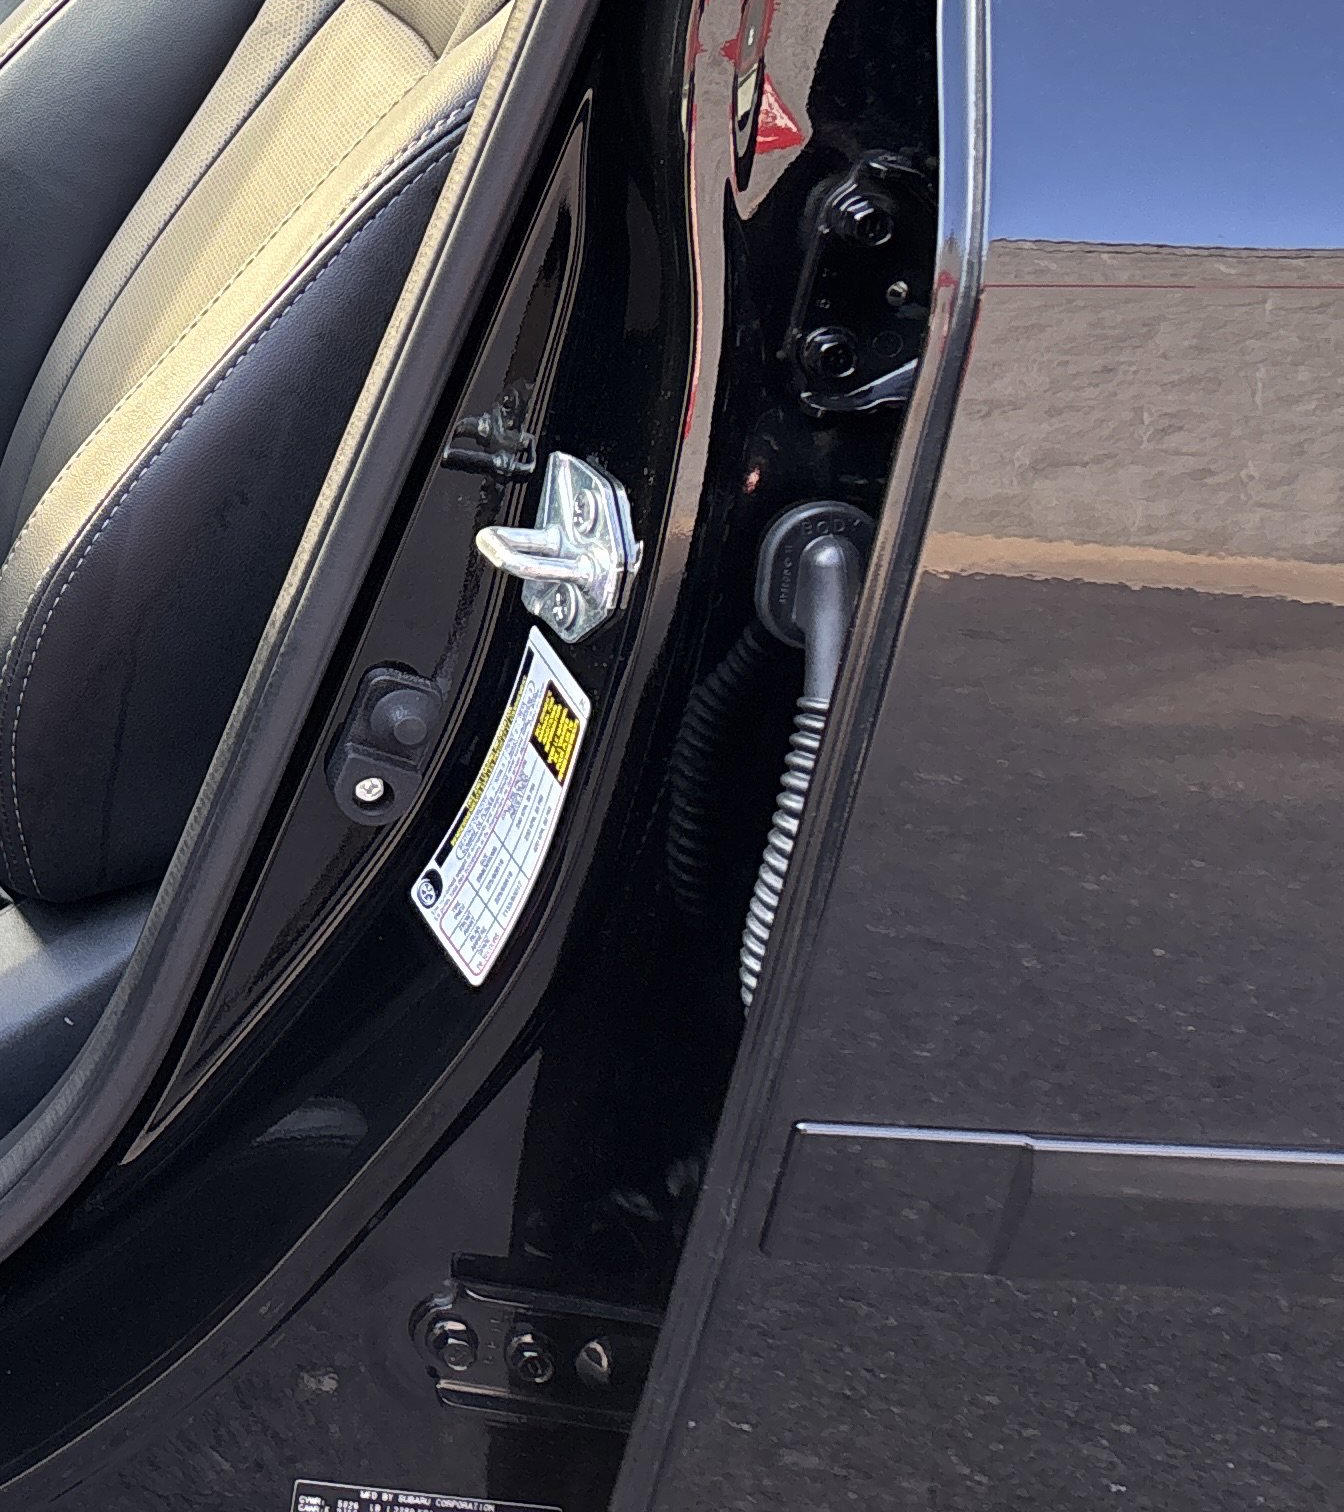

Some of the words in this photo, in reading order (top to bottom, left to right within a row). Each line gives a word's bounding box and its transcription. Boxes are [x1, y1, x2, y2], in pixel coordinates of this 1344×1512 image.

[382, 1492, 394, 1501] BY
[397, 1494, 431, 1506] SUBARU
[435, 1498, 496, 1512] CORPORATION
